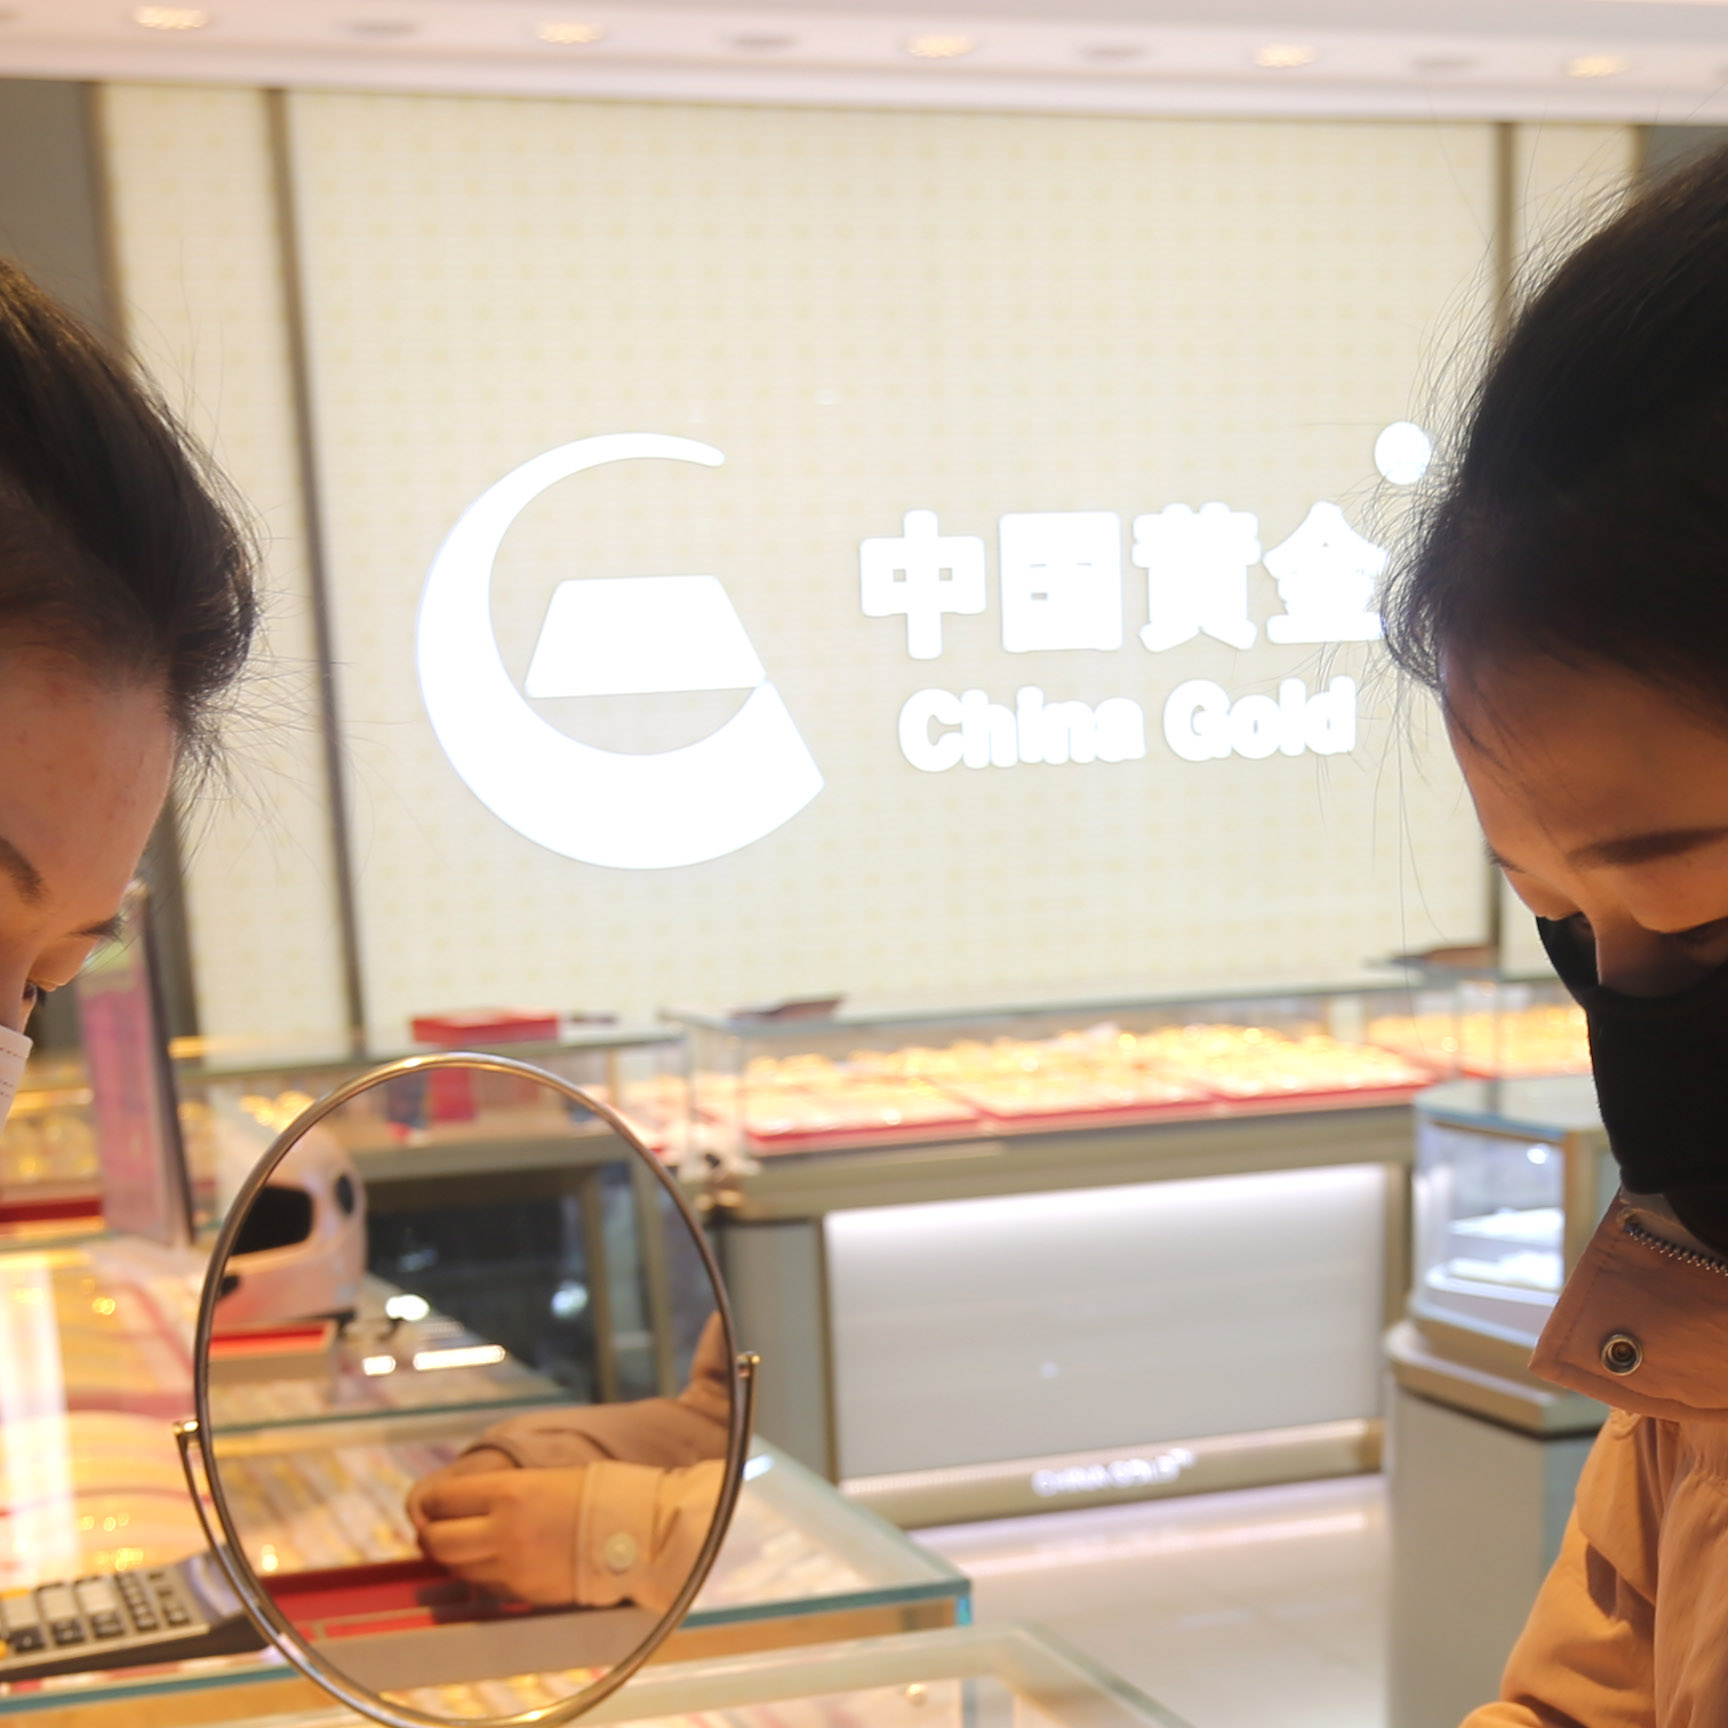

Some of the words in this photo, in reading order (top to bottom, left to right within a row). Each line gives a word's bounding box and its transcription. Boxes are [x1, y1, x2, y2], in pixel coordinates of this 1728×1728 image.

[858, 501, 1388, 660] 中国黄金
[898, 684, 1146, 773] China
[1163, 676, 1358, 762] Gold
